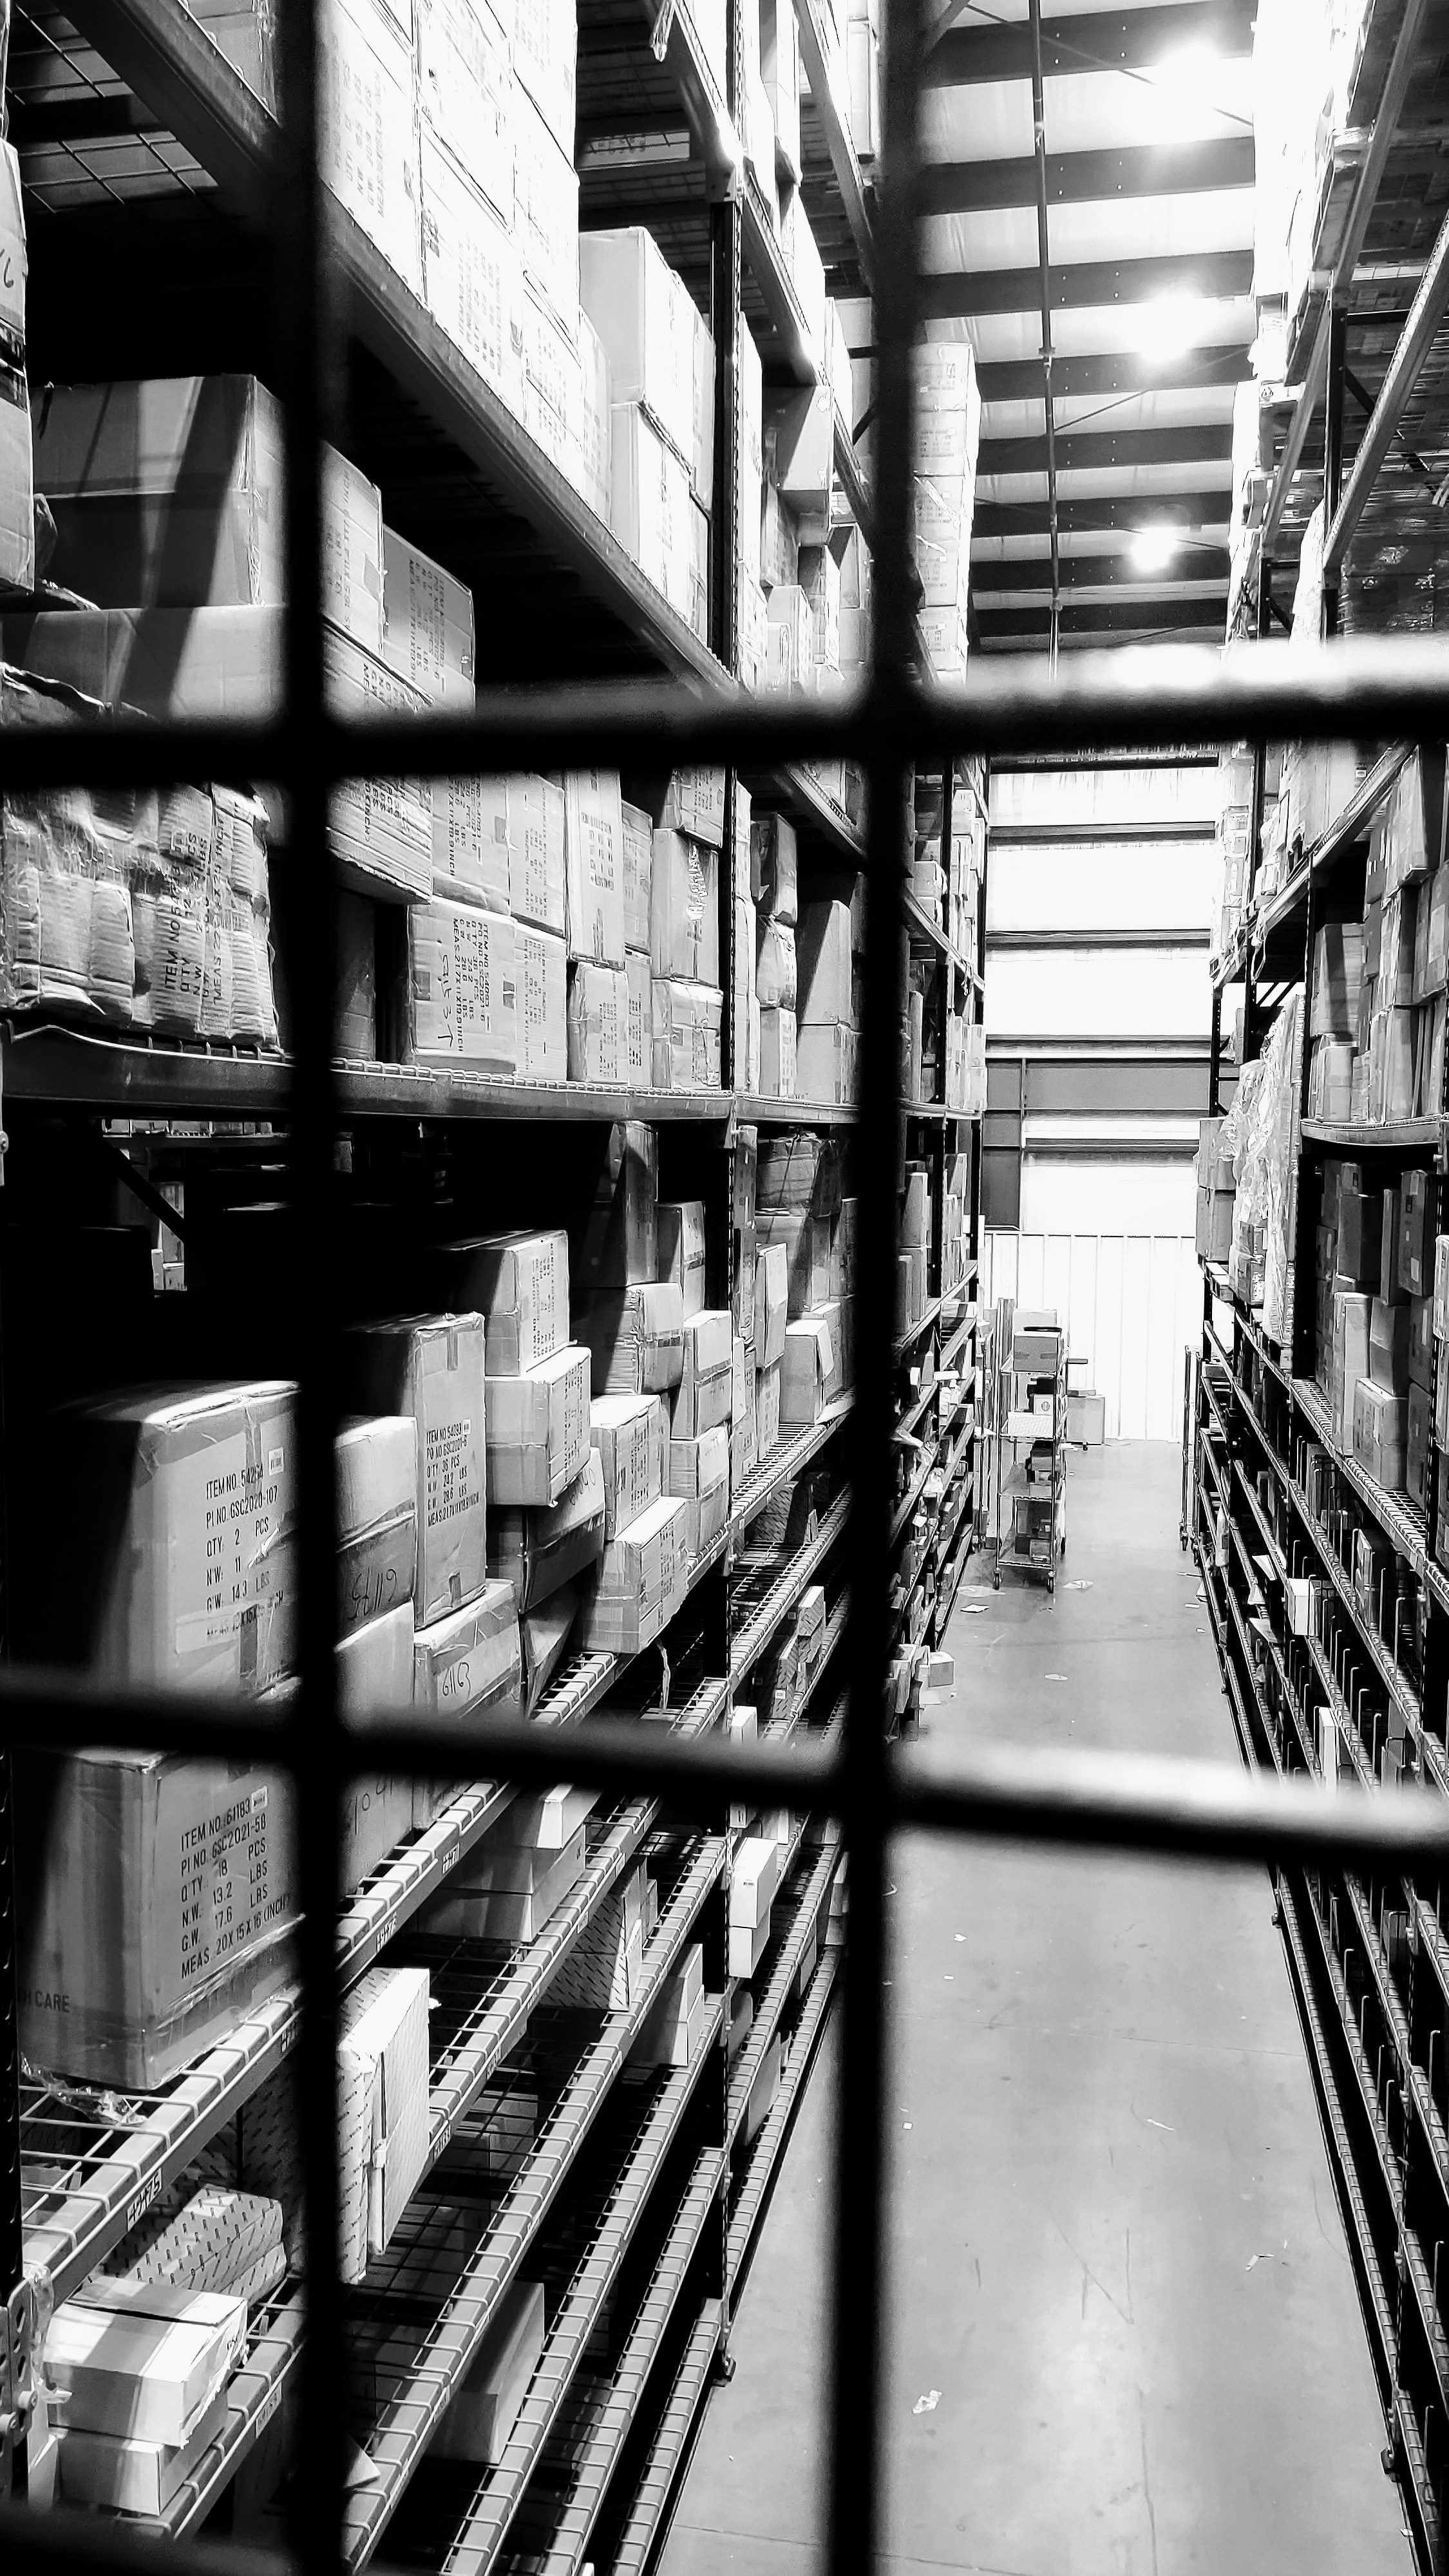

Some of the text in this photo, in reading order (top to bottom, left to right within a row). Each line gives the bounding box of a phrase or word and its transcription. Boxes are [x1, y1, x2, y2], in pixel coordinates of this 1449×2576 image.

[170, 920, 180, 942] NO
[478, 922, 482, 936] PO
[164, 950, 178, 990] ITEM
[426, 1429, 439, 1444] ITEM
[427, 1447, 434, 1461] PO
[451, 1454, 460, 1469] PCS
[206, 1475, 225, 1501] ITEM
[206, 1484, 278, 1530] PI GSC2020-107
[234, 1528, 240, 1546] 2
[255, 1516, 269, 1537] PCS
[235, 1555, 241, 1573] 11
[232, 1580, 248, 1602] 14.3
[256, 1570, 270, 1593] LBS
[181, 1797, 251, 1852] ITEM 61183
[181, 1857, 190, 1878] PI
[218, 1837, 266, 1878] 18 PCS
[213, 1881, 232, 1905] 13.2
[249, 1860, 267, 1885] LBS
[214, 1906, 232, 1931] 17.6
[249, 1883, 268, 1909] LBS
[35, 1990, 70, 2013] CARE
